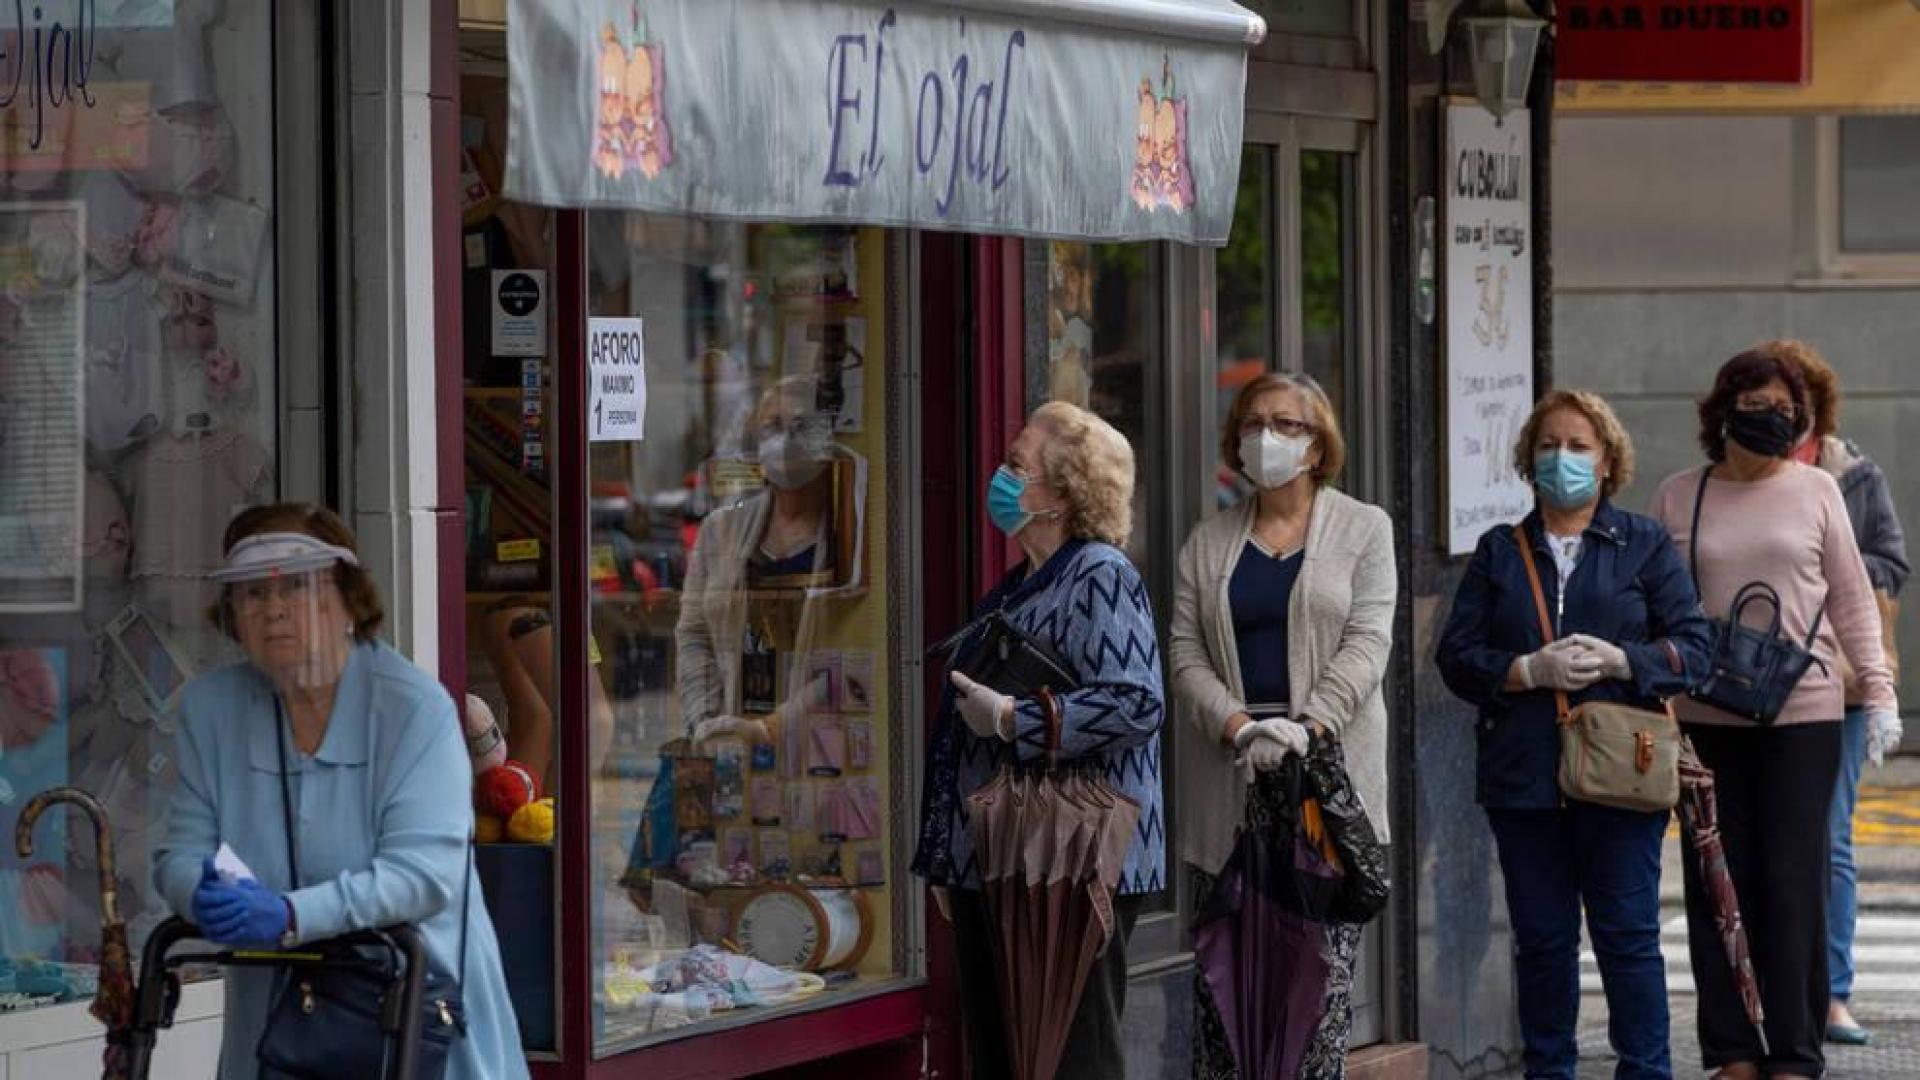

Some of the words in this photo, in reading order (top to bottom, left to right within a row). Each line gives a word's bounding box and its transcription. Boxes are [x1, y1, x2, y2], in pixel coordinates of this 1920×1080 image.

[1567, 5, 1645, 31] BAR
[1659, 5, 1790, 31] DUERO
[823, 8, 897, 187] El
[917, 16, 1025, 214] ojal
[591, 331, 641, 366] AFORO
[594, 396, 602, 436] 1
